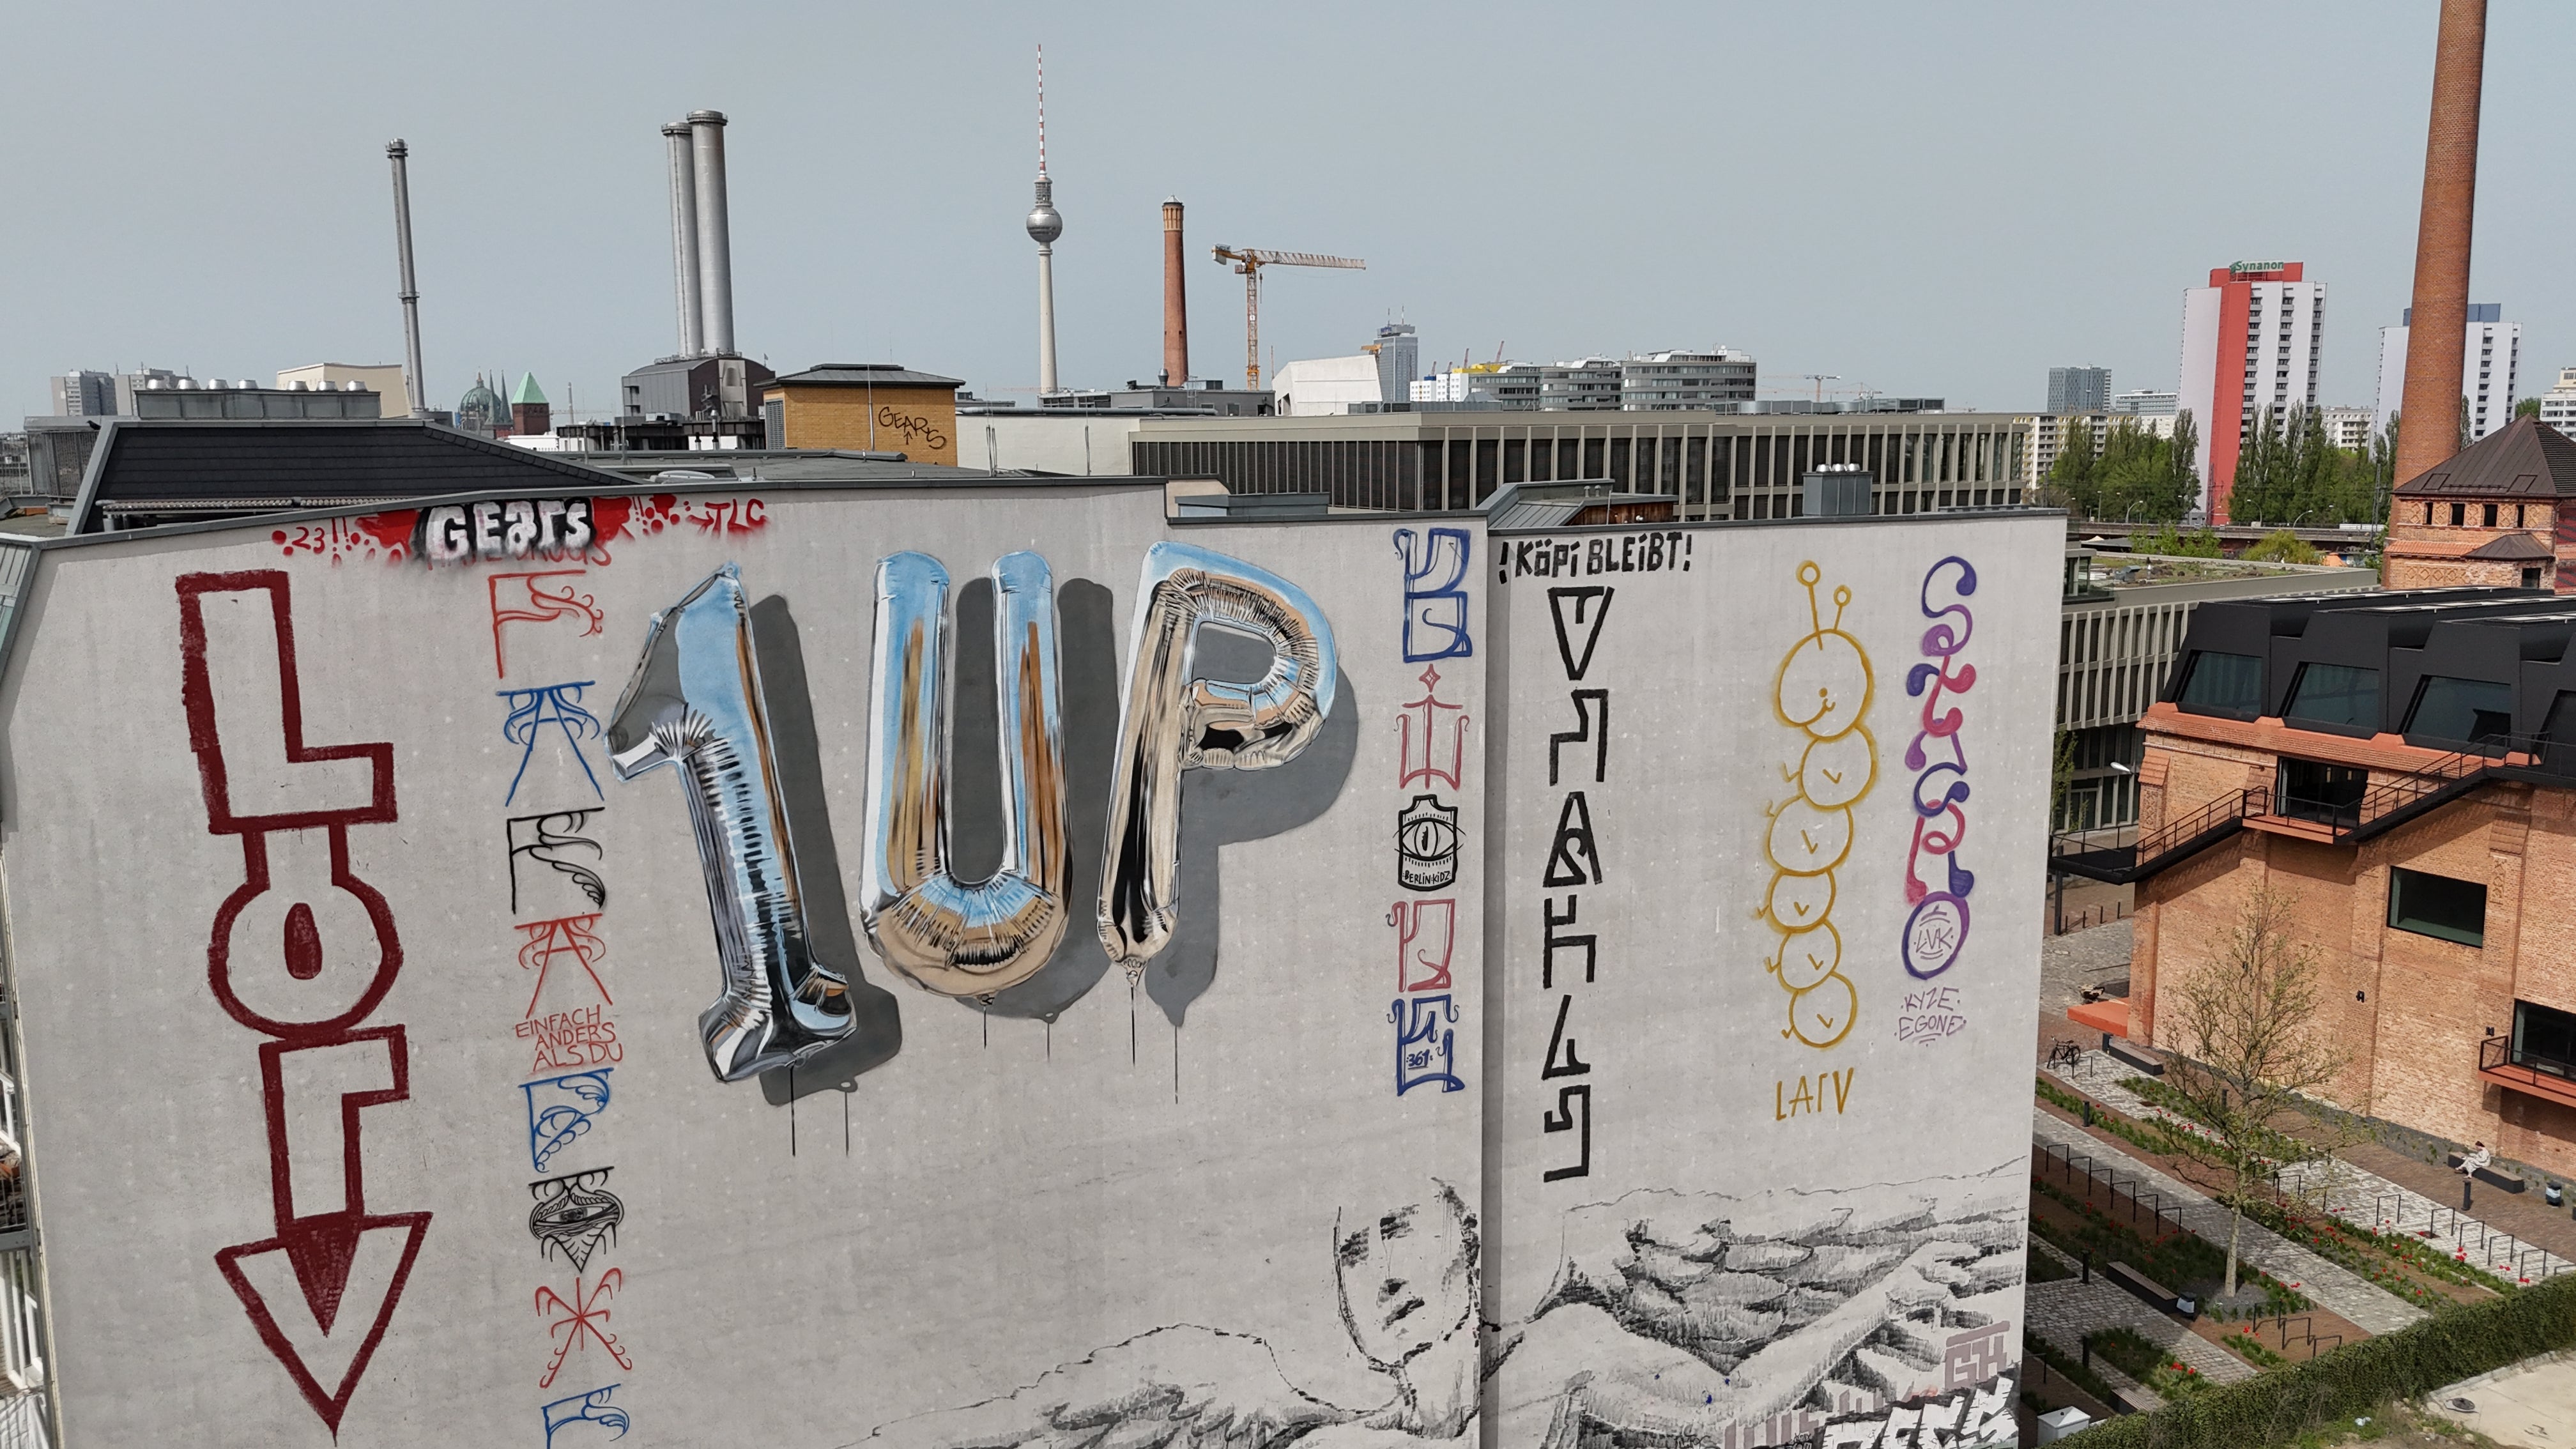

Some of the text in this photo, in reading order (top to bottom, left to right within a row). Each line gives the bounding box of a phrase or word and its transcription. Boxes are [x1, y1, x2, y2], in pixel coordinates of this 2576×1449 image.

[2236, 260, 2284, 272] Synanon
[878, 406, 947, 449] GEARS
[604, 540, 1337, 1083] 1UP
[515, 1004, 601, 1038] EINFACH
[535, 1022, 617, 1051] ANDERS
[533, 1043, 624, 1071] ALS DU
